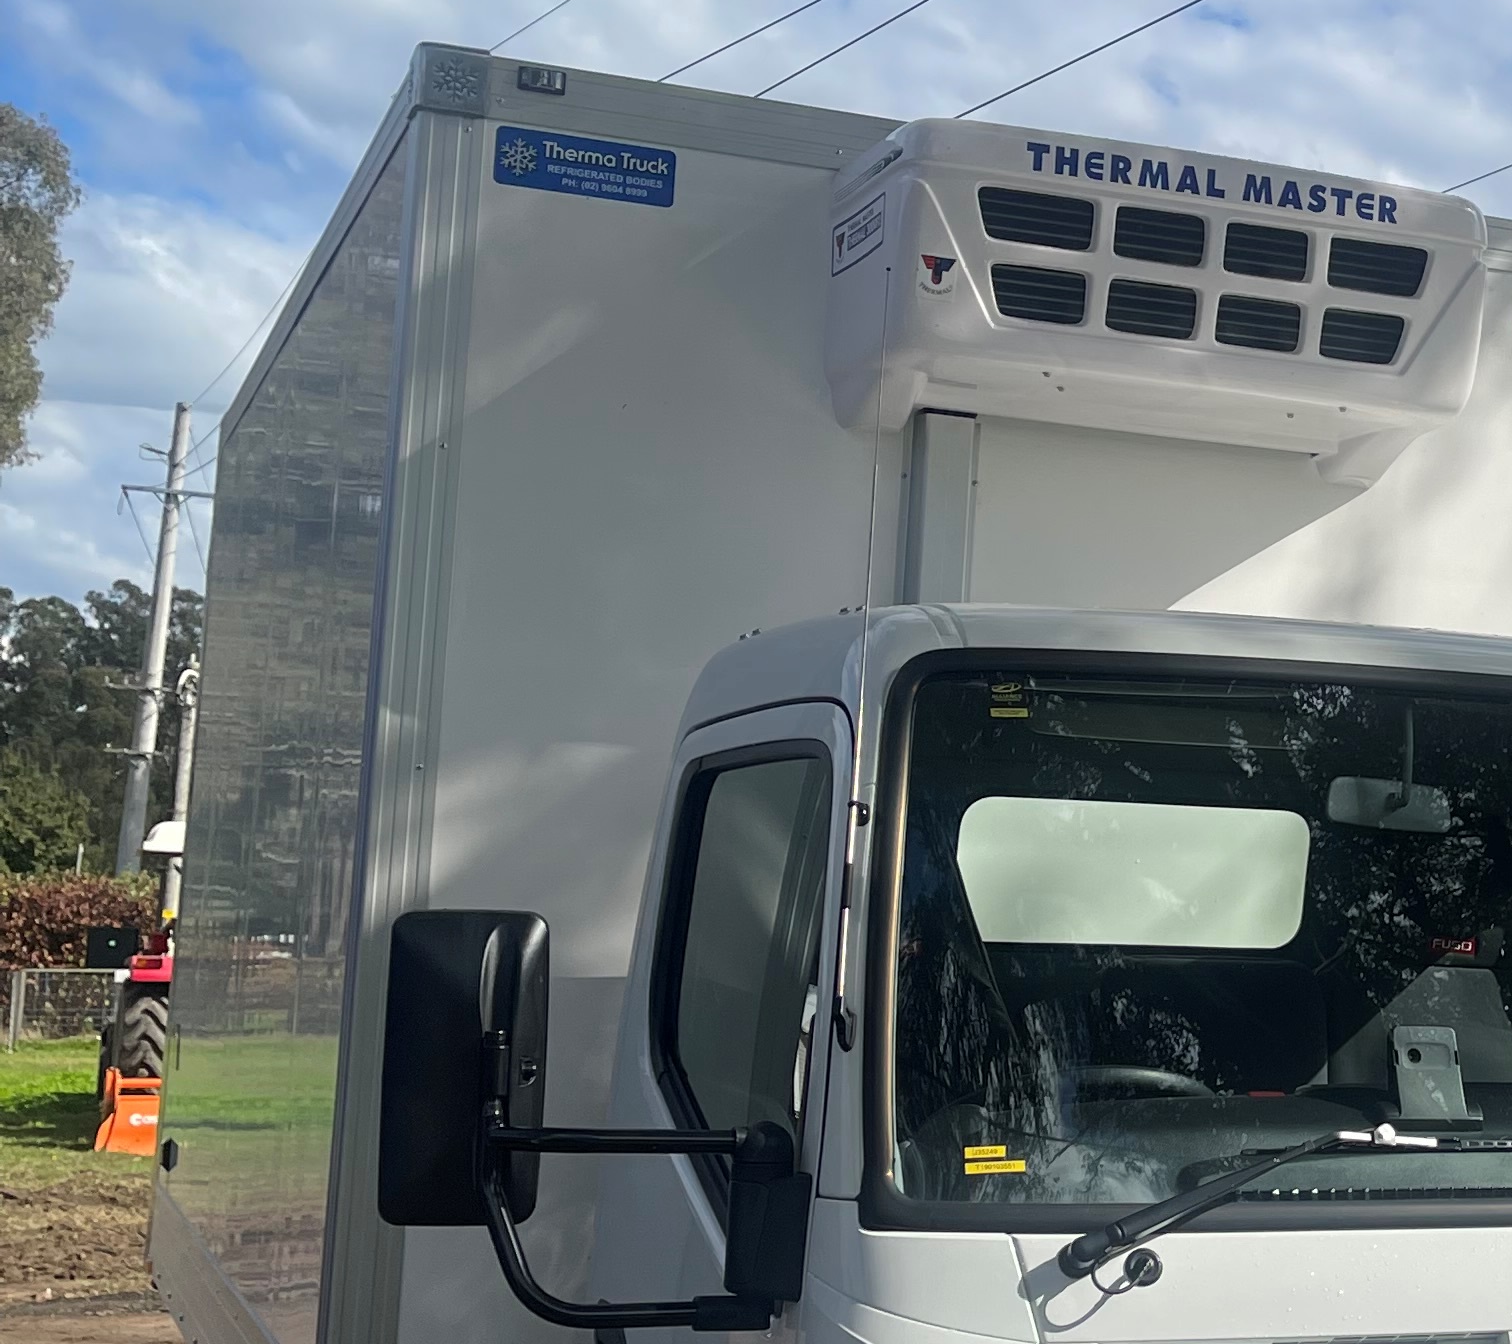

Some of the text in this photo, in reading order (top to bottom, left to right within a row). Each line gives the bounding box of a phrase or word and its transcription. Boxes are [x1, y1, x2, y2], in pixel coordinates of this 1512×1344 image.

[543, 141, 669, 175] Therma Truck
[547, 164, 663, 189] REFRIGERATED BODIES
[1026, 141, 1398, 224] THERMAL MASTER
